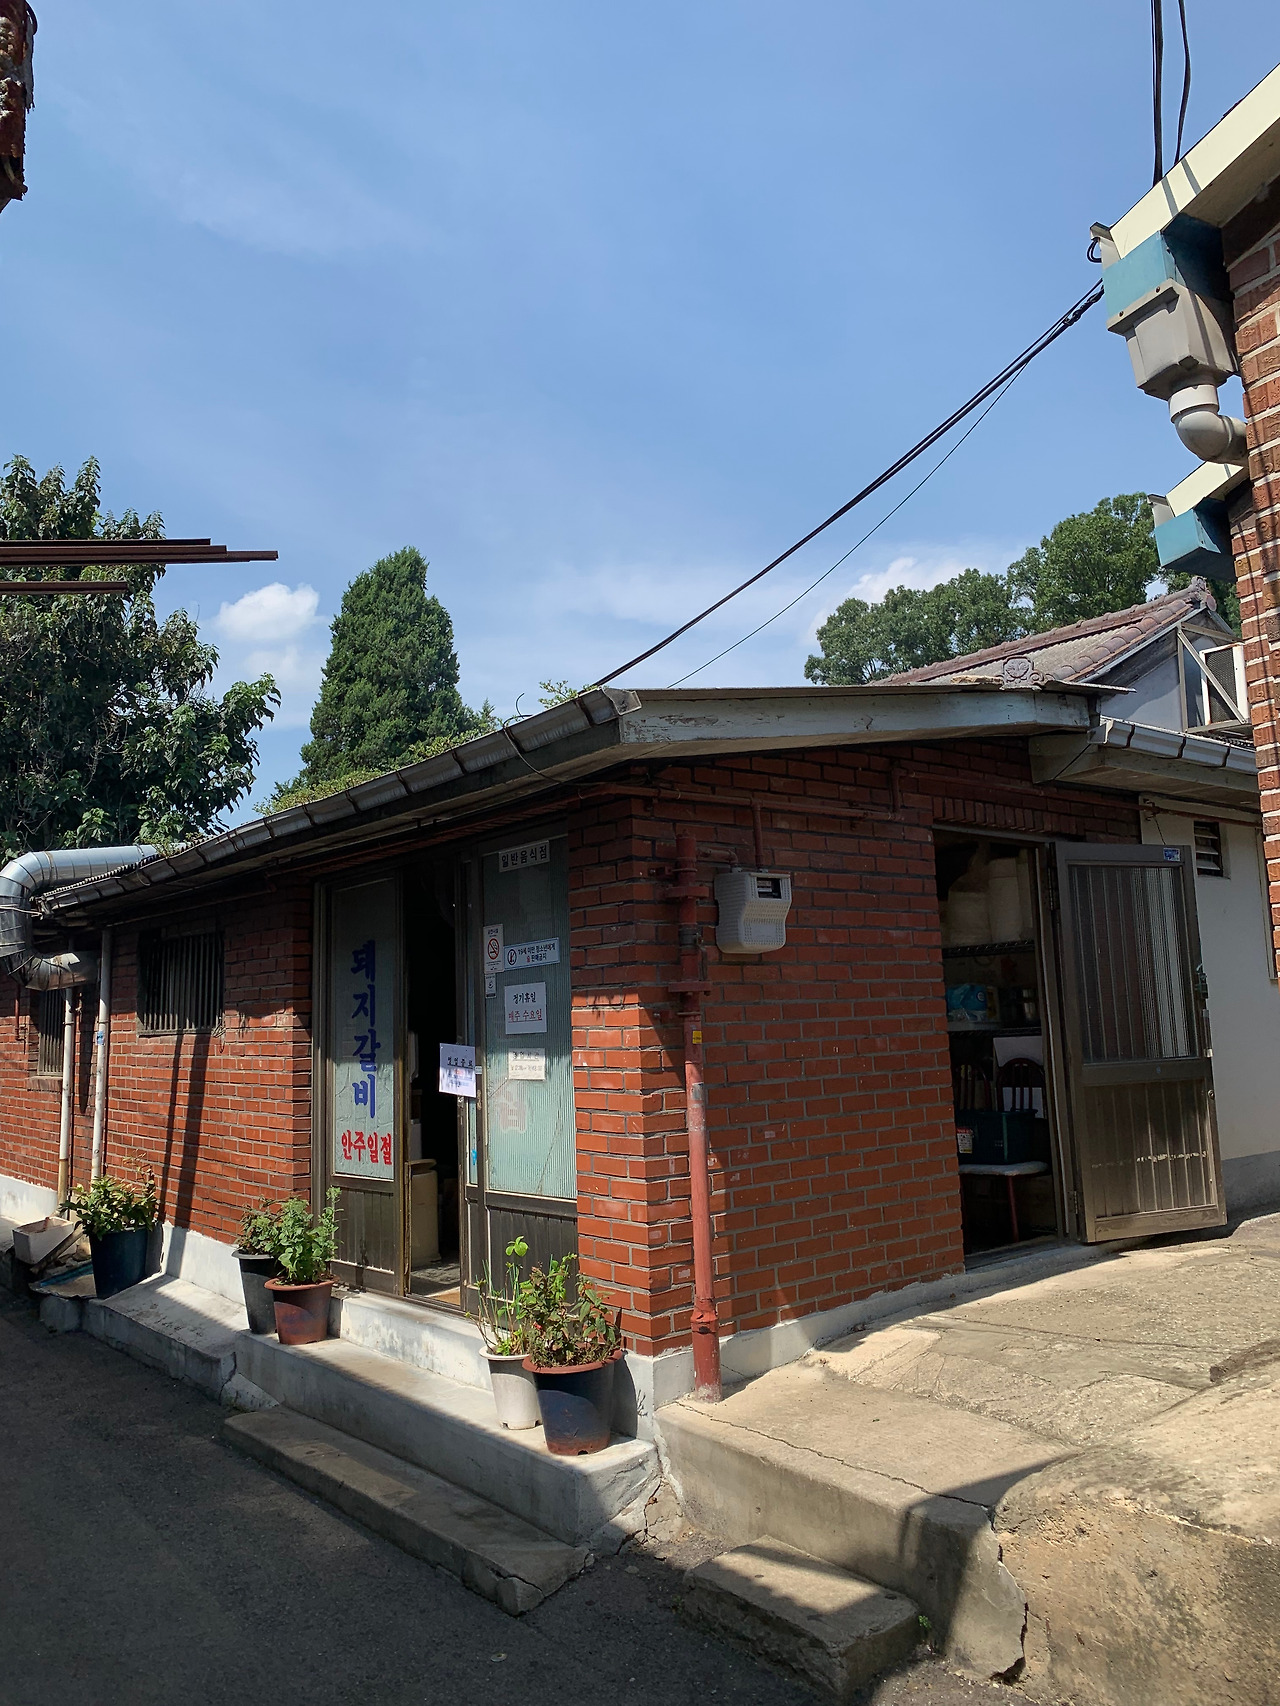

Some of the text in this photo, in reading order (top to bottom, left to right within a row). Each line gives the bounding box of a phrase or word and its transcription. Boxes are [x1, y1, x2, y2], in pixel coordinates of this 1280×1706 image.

[502, 845, 547, 867] 일반음식점
[513, 991, 536, 1004] 정기휴일
[508, 1008, 542, 1021] 매주 수요일
[350, 939, 382, 1119] 돼지갈비
[341, 1129, 392, 1165] 안주일절
